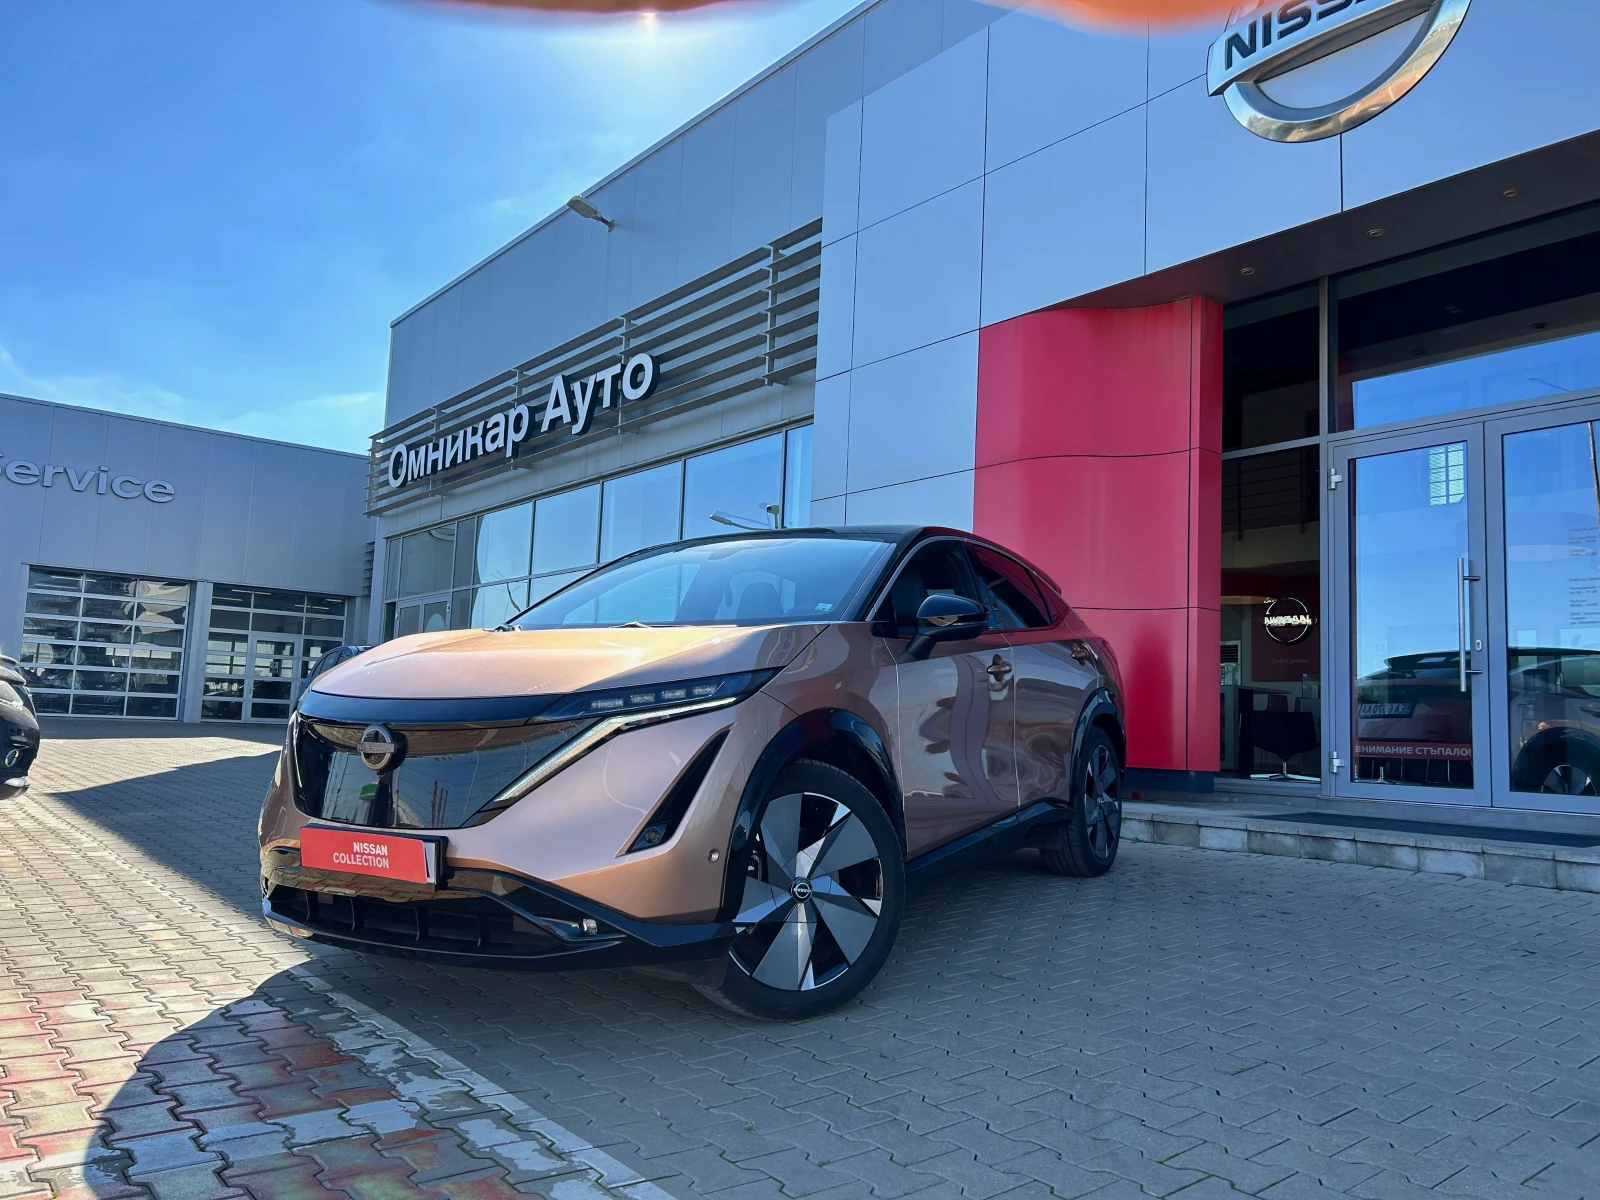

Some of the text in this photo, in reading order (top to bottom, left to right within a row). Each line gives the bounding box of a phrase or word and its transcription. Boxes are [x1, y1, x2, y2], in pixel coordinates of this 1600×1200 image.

[388, 352, 656, 488] Омникар Ауто
[0, 452, 175, 503] ervice
[357, 743, 394, 751] NISSAN
[1355, 745, 1472, 757] ВНИМАНИЕ СТЪПАЛО!
[353, 842, 388, 856] NISSAN
[333, 852, 389, 868] COLLECTION
